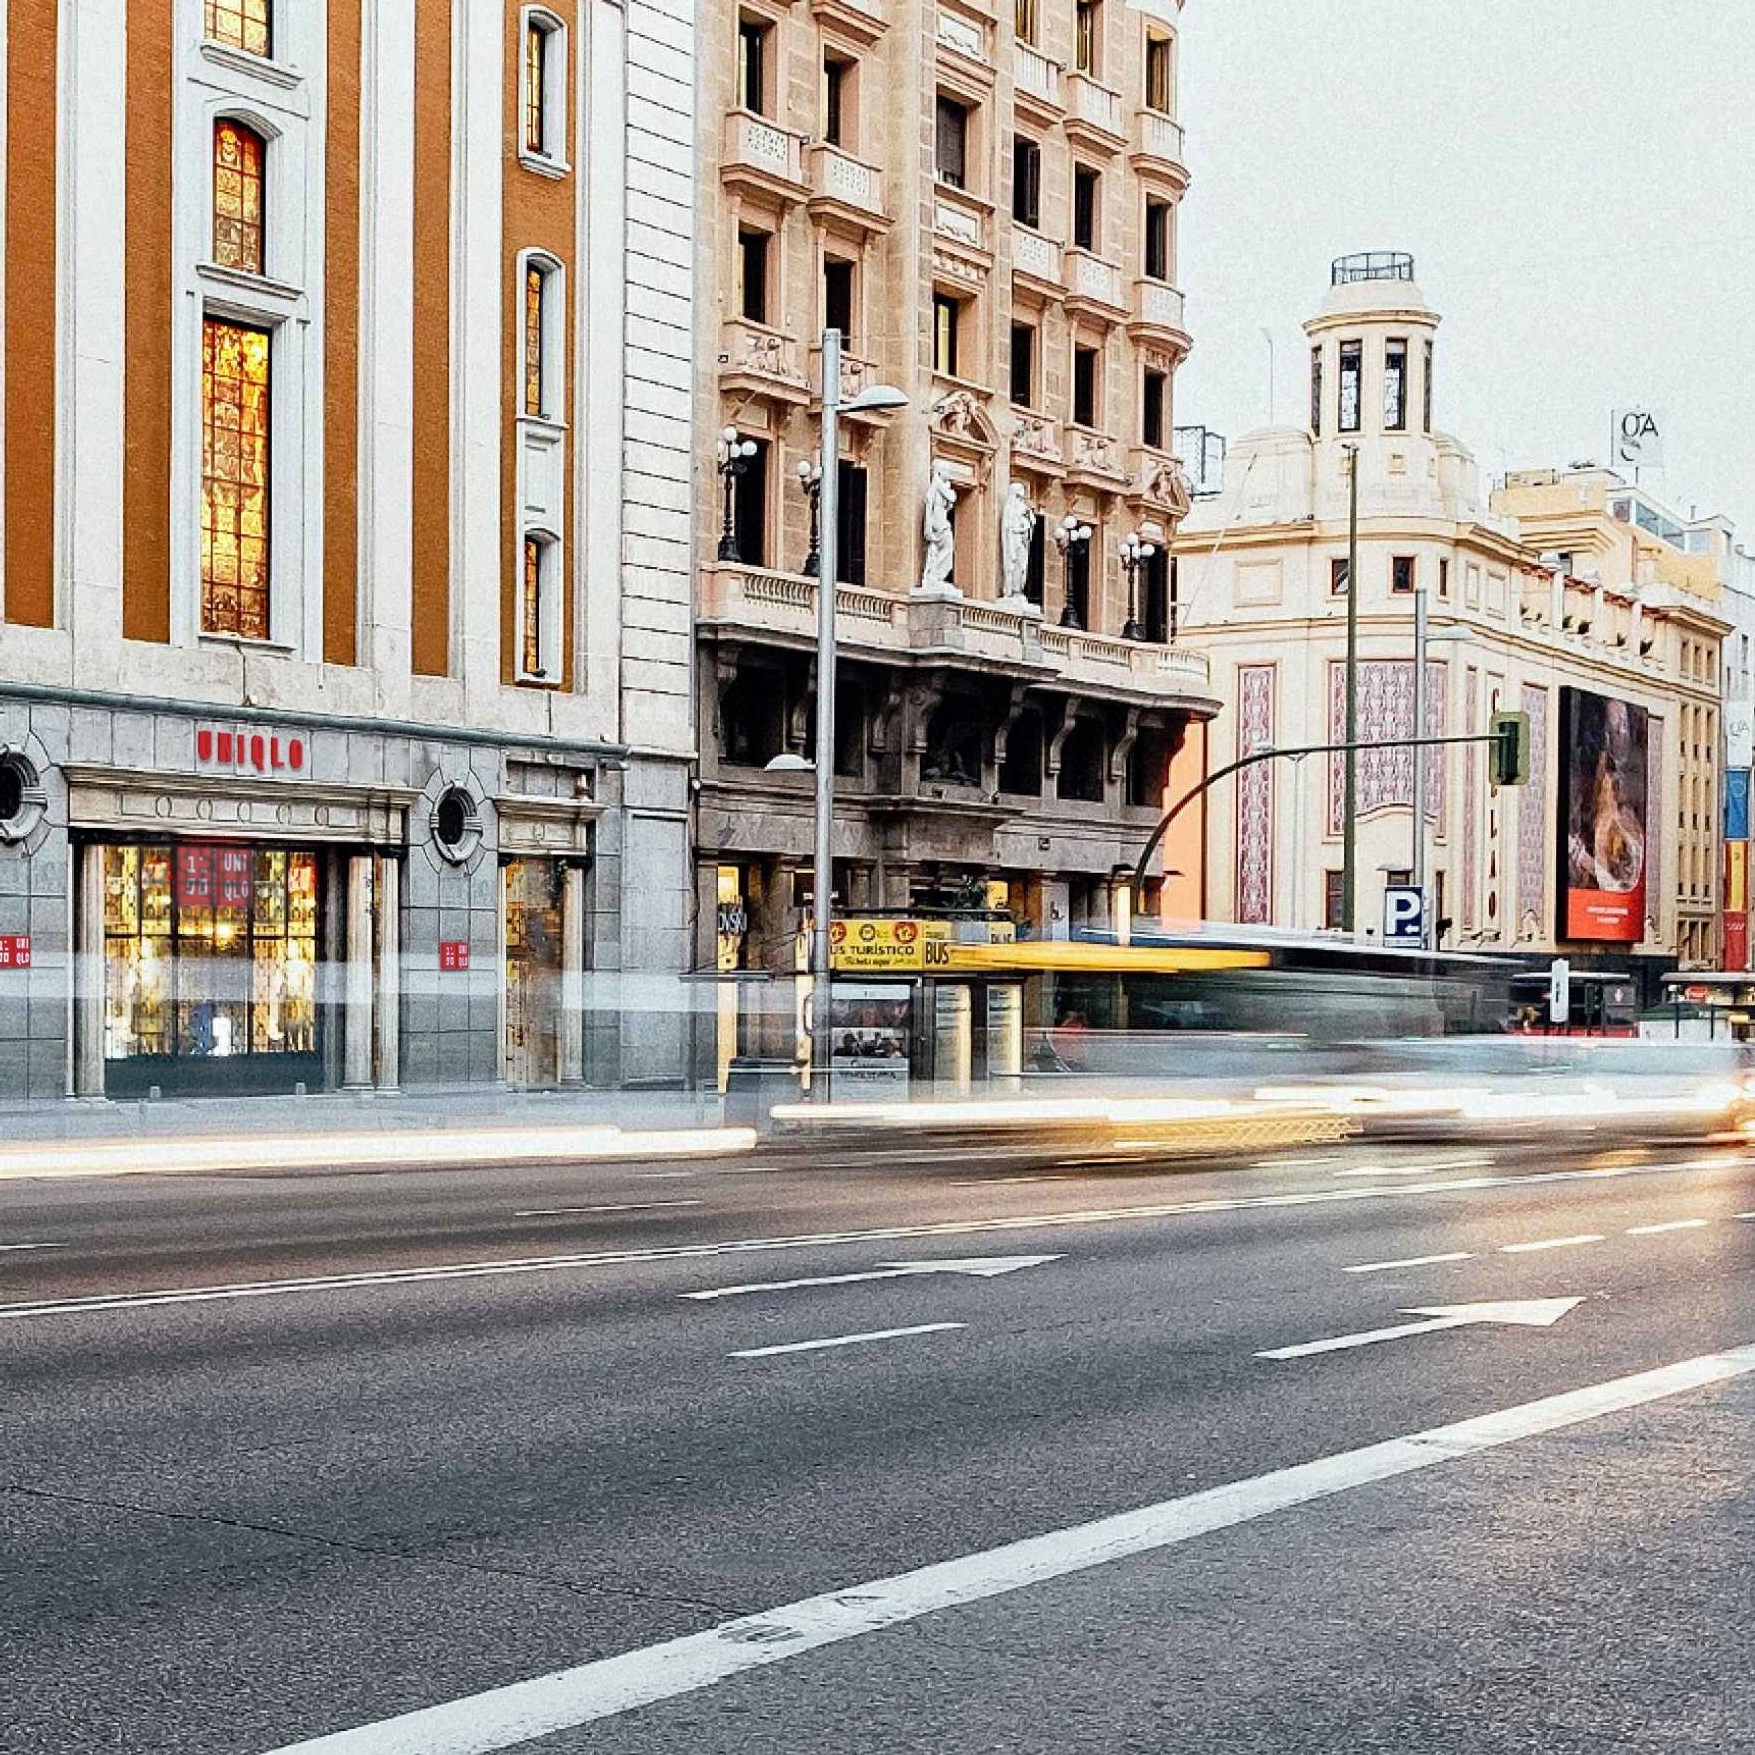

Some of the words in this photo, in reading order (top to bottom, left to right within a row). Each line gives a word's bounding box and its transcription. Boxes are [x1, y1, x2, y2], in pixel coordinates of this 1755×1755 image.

[198, 730, 302, 771] UNIQLO
[224, 853, 247, 872] UNI
[224, 880, 249, 901] QLO
[1386, 890, 1420, 935] P
[16, 938, 29, 949] UNI
[830, 945, 846, 955] US
[850, 943, 915, 956] TURÍSTICO
[16, 952, 30, 965] QLO
[925, 943, 949, 965] BUS
